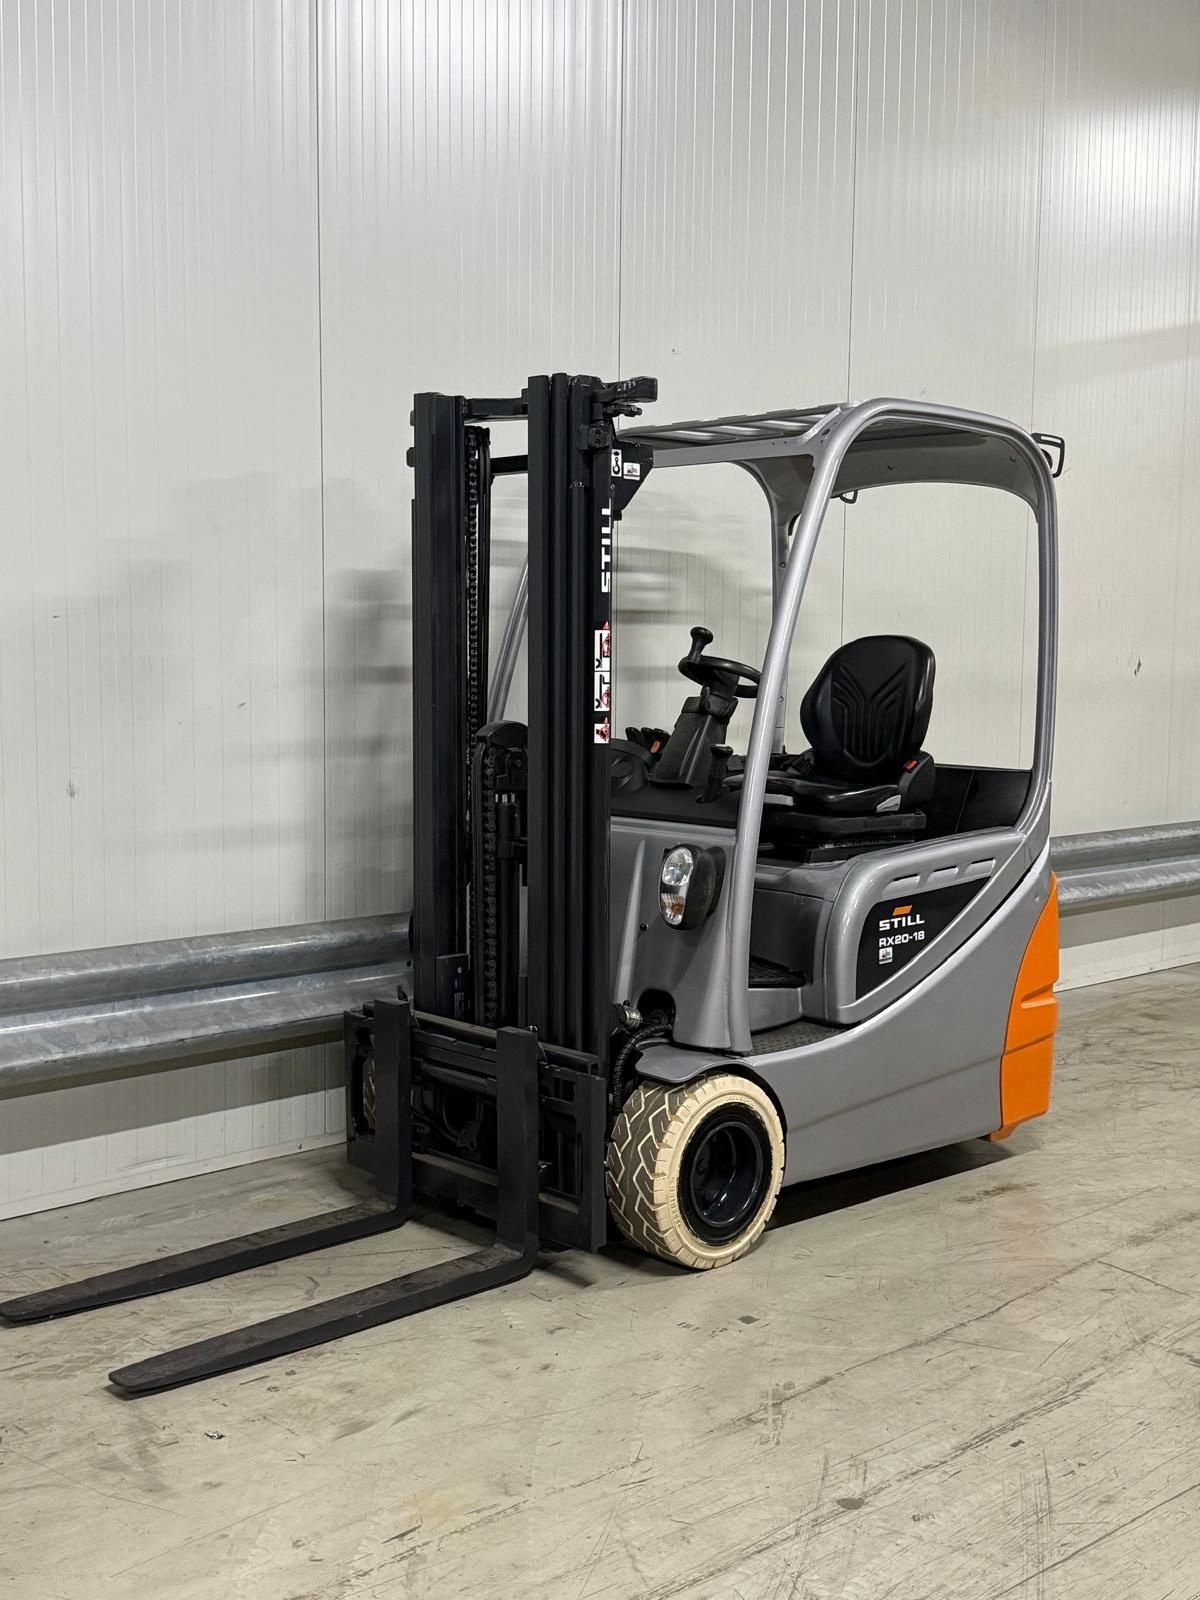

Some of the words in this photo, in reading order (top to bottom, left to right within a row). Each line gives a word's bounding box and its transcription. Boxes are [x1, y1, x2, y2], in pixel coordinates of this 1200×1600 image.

[601, 498, 611, 593] STILL
[879, 914, 925, 931] STILL
[879, 930, 925, 948] RX20-18
